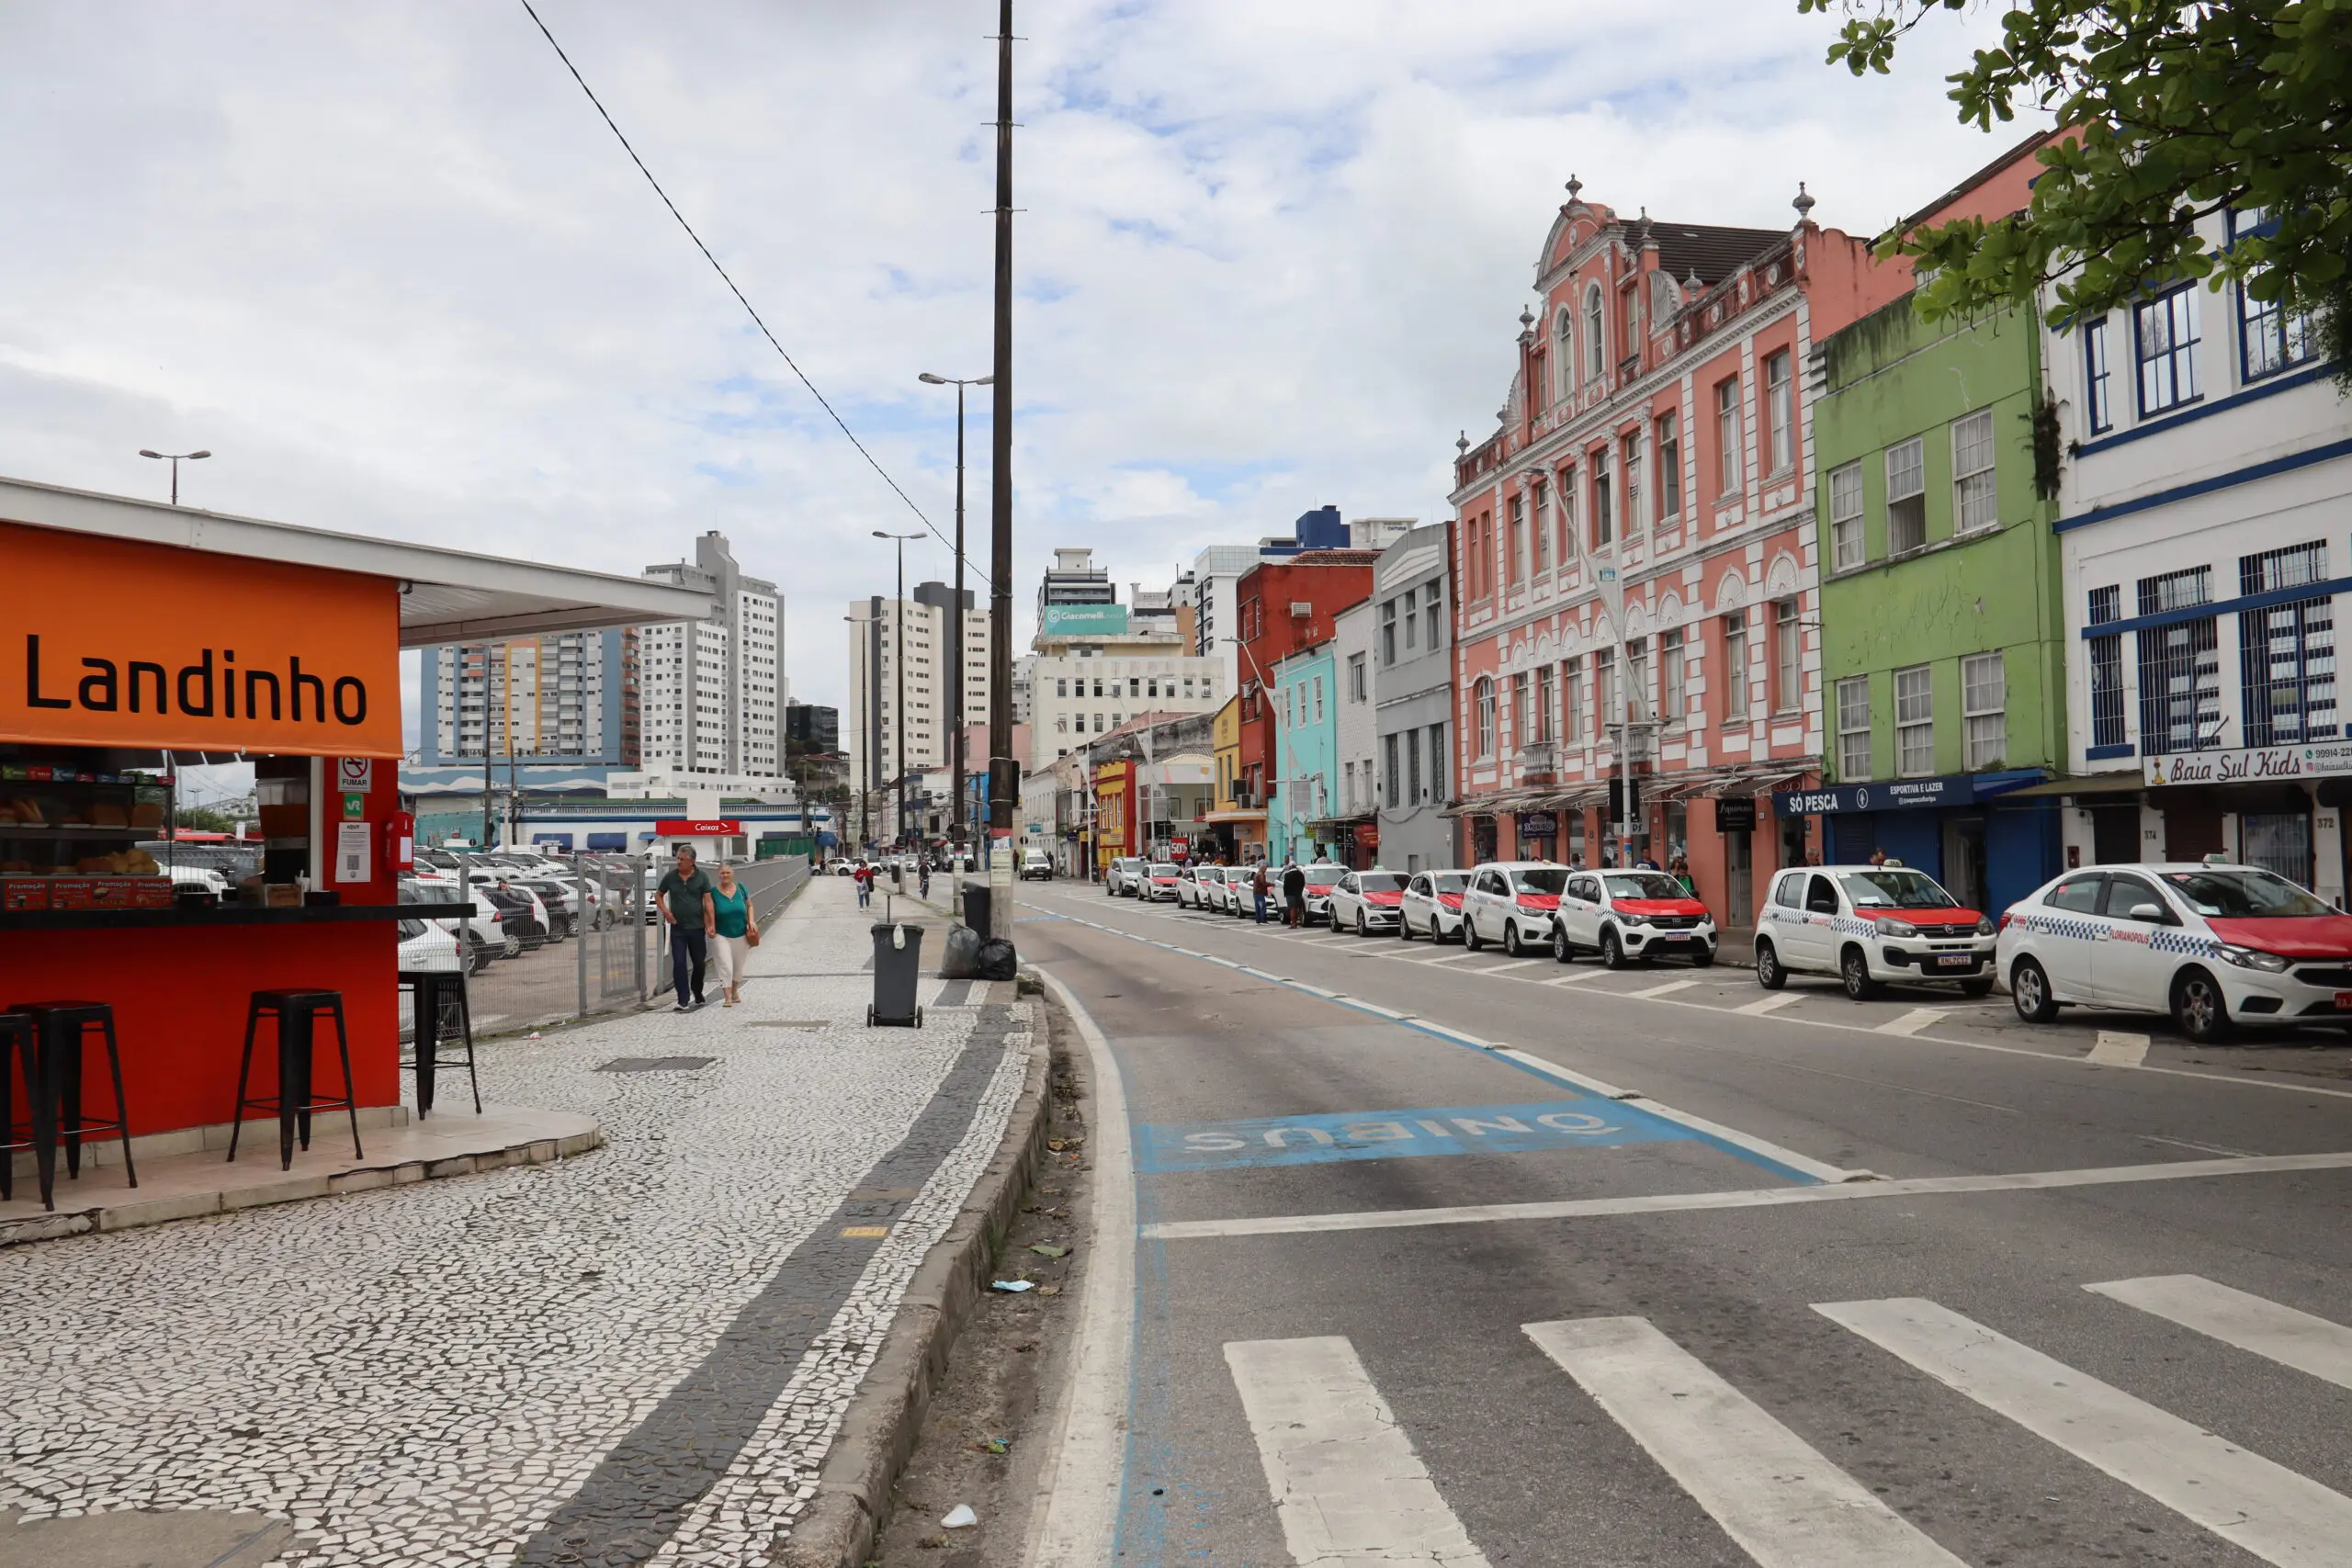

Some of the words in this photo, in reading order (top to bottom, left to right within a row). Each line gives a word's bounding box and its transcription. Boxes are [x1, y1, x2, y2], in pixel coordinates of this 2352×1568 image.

[1061, 611, 1103, 620] Giacomelli
[27, 634, 367, 726] Landinho
[2170, 757, 2211, 783] Baia
[2217, 753, 2250, 781] Sul
[2254, 750, 2301, 776] Kids
[1890, 784, 1920, 795] ESPORTIVA
[1920, 784, 1925, 793] E
[1925, 782, 1944, 792] LAZER
[1790, 793, 1802, 813] SÓ
[1805, 794, 1838, 812] PESCA
[695, 823, 719, 831] Caixas
[2317, 818, 2335, 829] 372
[1183, 1112, 1623, 1153] ÔNIBUS
